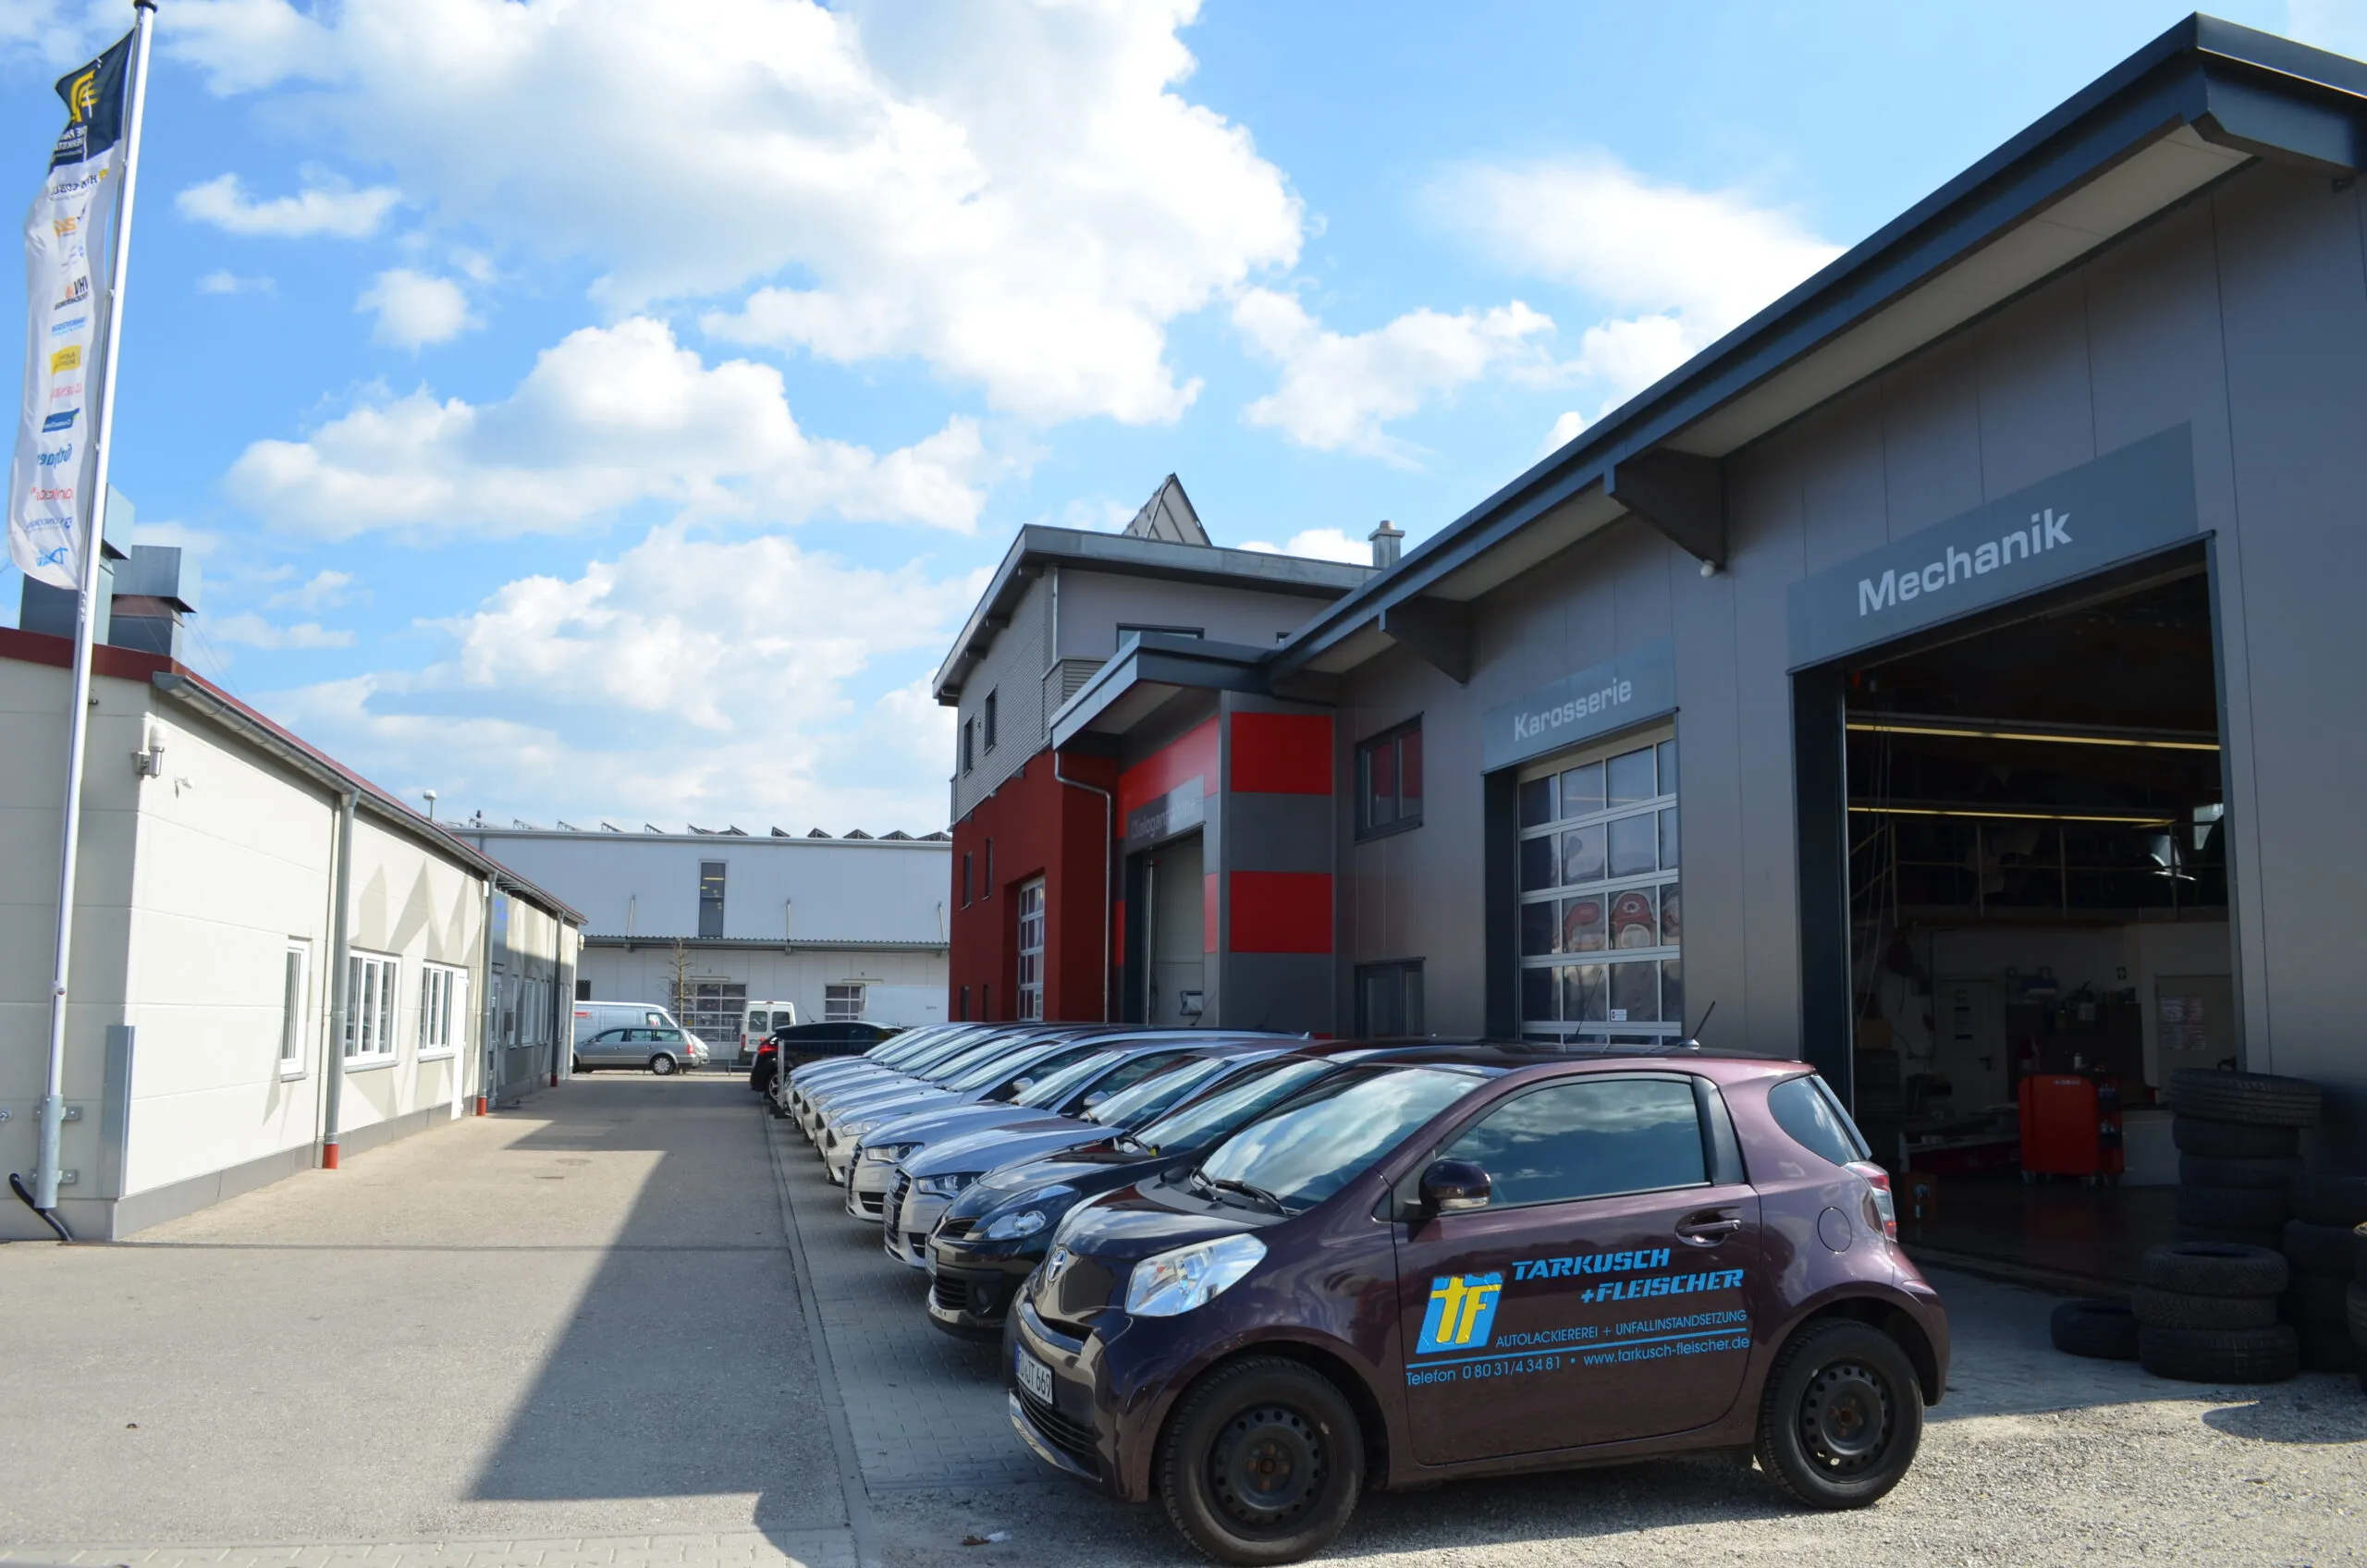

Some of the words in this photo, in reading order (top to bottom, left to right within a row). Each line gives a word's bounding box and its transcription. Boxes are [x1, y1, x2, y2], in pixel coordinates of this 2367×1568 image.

[1857, 508, 2073, 617] Mechanik
[1514, 677, 1632, 742] Karosserie
[1512, 1248, 1671, 1280] TARKUSCH
[1495, 1326, 1598, 1348] AUTOLACKIEREREI
[1615, 1309, 1748, 1336] UNFALLINSTANDSETZUNG
[1405, 1368, 1456, 1386] Telefon
[1583, 1336, 1749, 1366] www.tarkusch-fleischer.de
